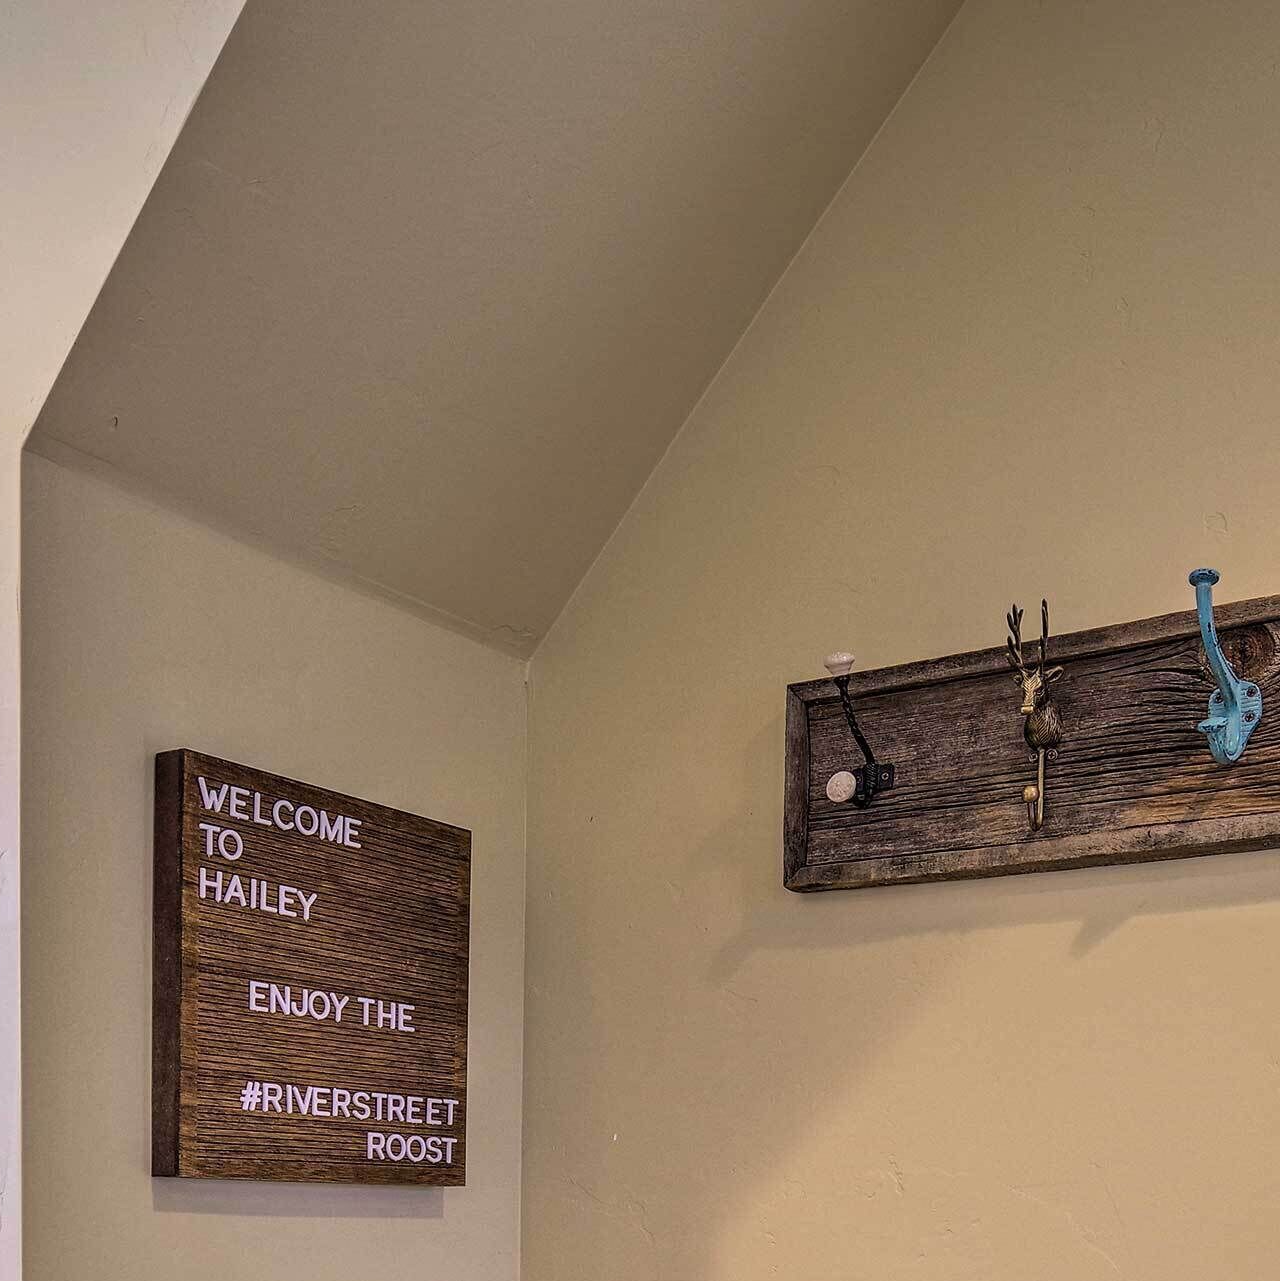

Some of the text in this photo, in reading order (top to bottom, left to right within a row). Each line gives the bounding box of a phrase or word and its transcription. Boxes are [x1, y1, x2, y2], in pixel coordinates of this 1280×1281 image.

[197, 776, 362, 849] WELCOME
[198, 822, 244, 861] TO
[199, 867, 317, 921] HAILEY
[248, 980, 416, 1033] ENJOY THE
[239, 1081, 459, 1126] #RIVERSTREET
[367, 1131, 458, 1165] ROOST
